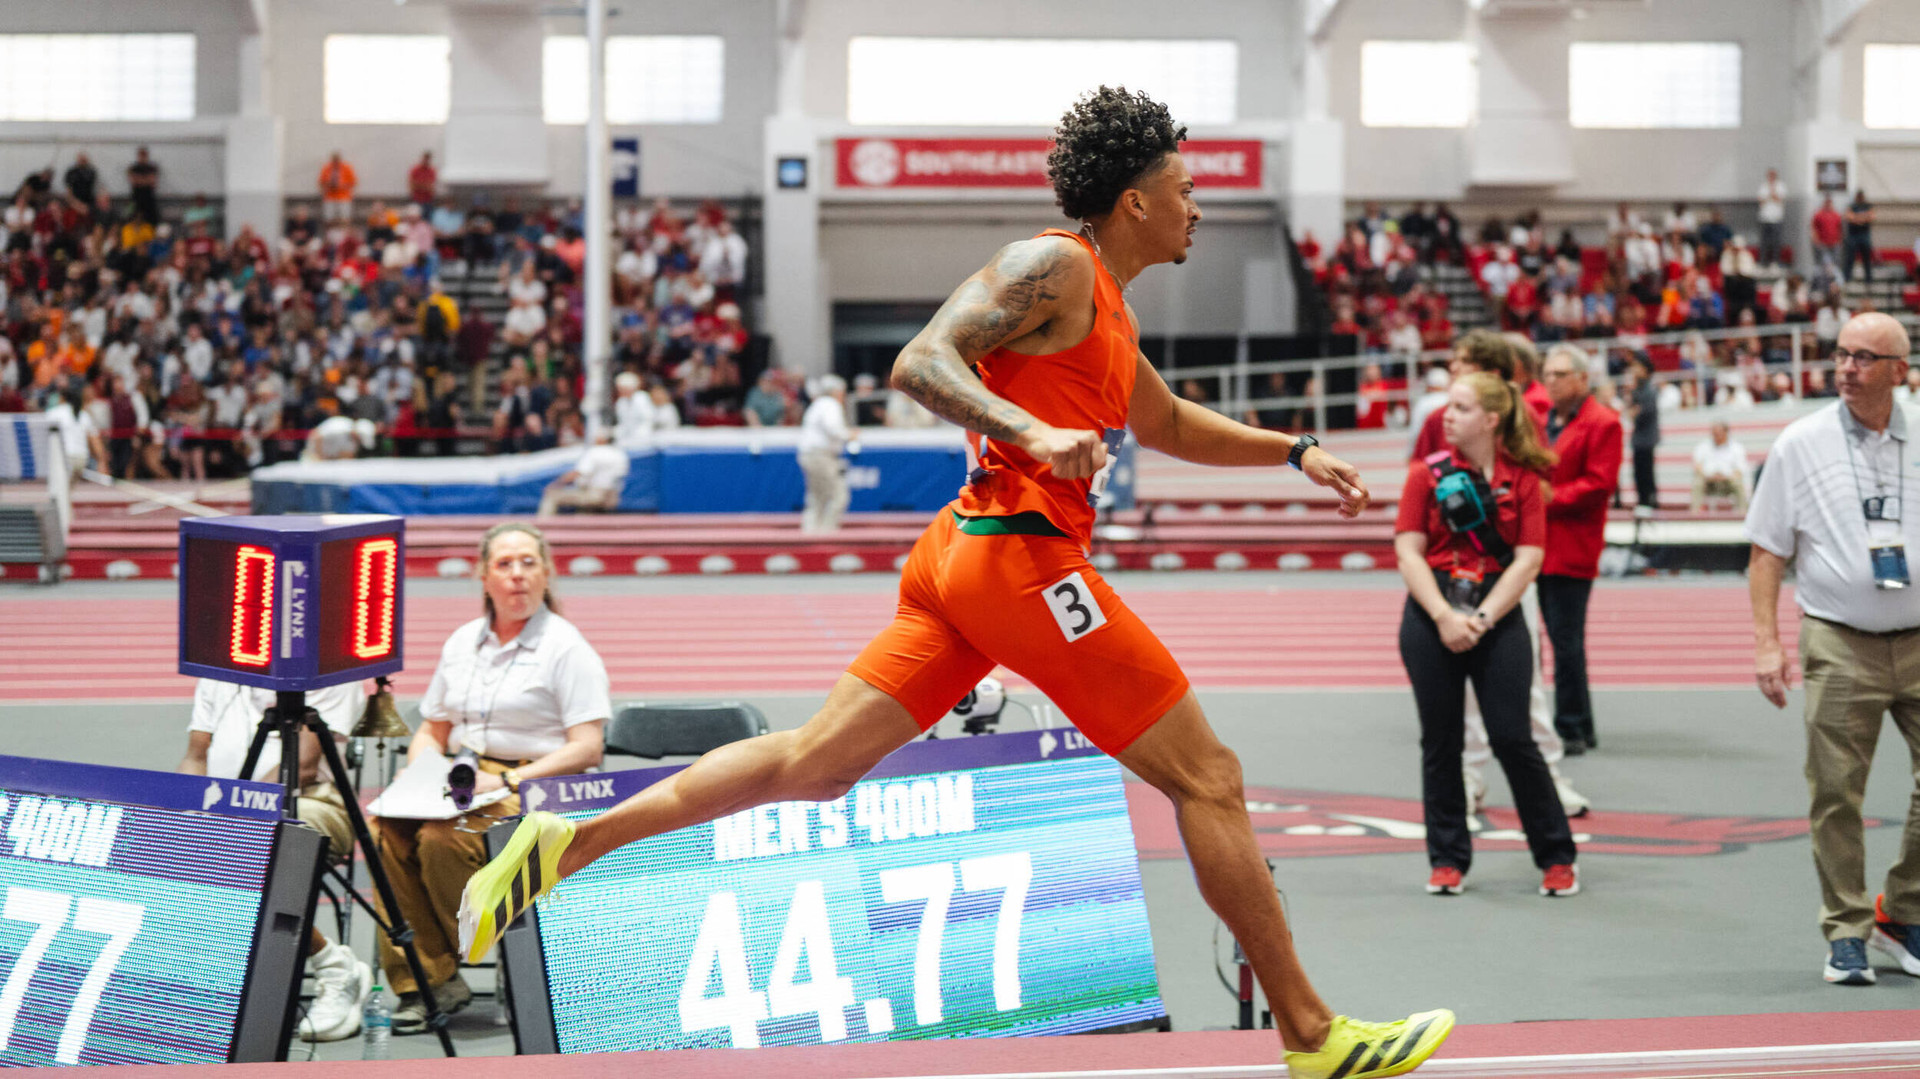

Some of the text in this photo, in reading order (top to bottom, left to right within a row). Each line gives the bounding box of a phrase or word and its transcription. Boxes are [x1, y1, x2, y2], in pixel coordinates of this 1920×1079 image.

[906, 151, 1047, 176] SOUTHEAST
[230, 545, 276, 666] 0
[292, 587, 306, 639] LYNX
[353, 539, 398, 659] 0
[1053, 582, 1092, 635] 3
[1063, 731, 1096, 750] LY
[230, 786, 280, 812] LYNX
[558, 779, 616, 803] LYNX
[855, 773, 977, 845] 400M
[5, 796, 124, 869] 400M
[678, 852, 1034, 1050] 44.77
